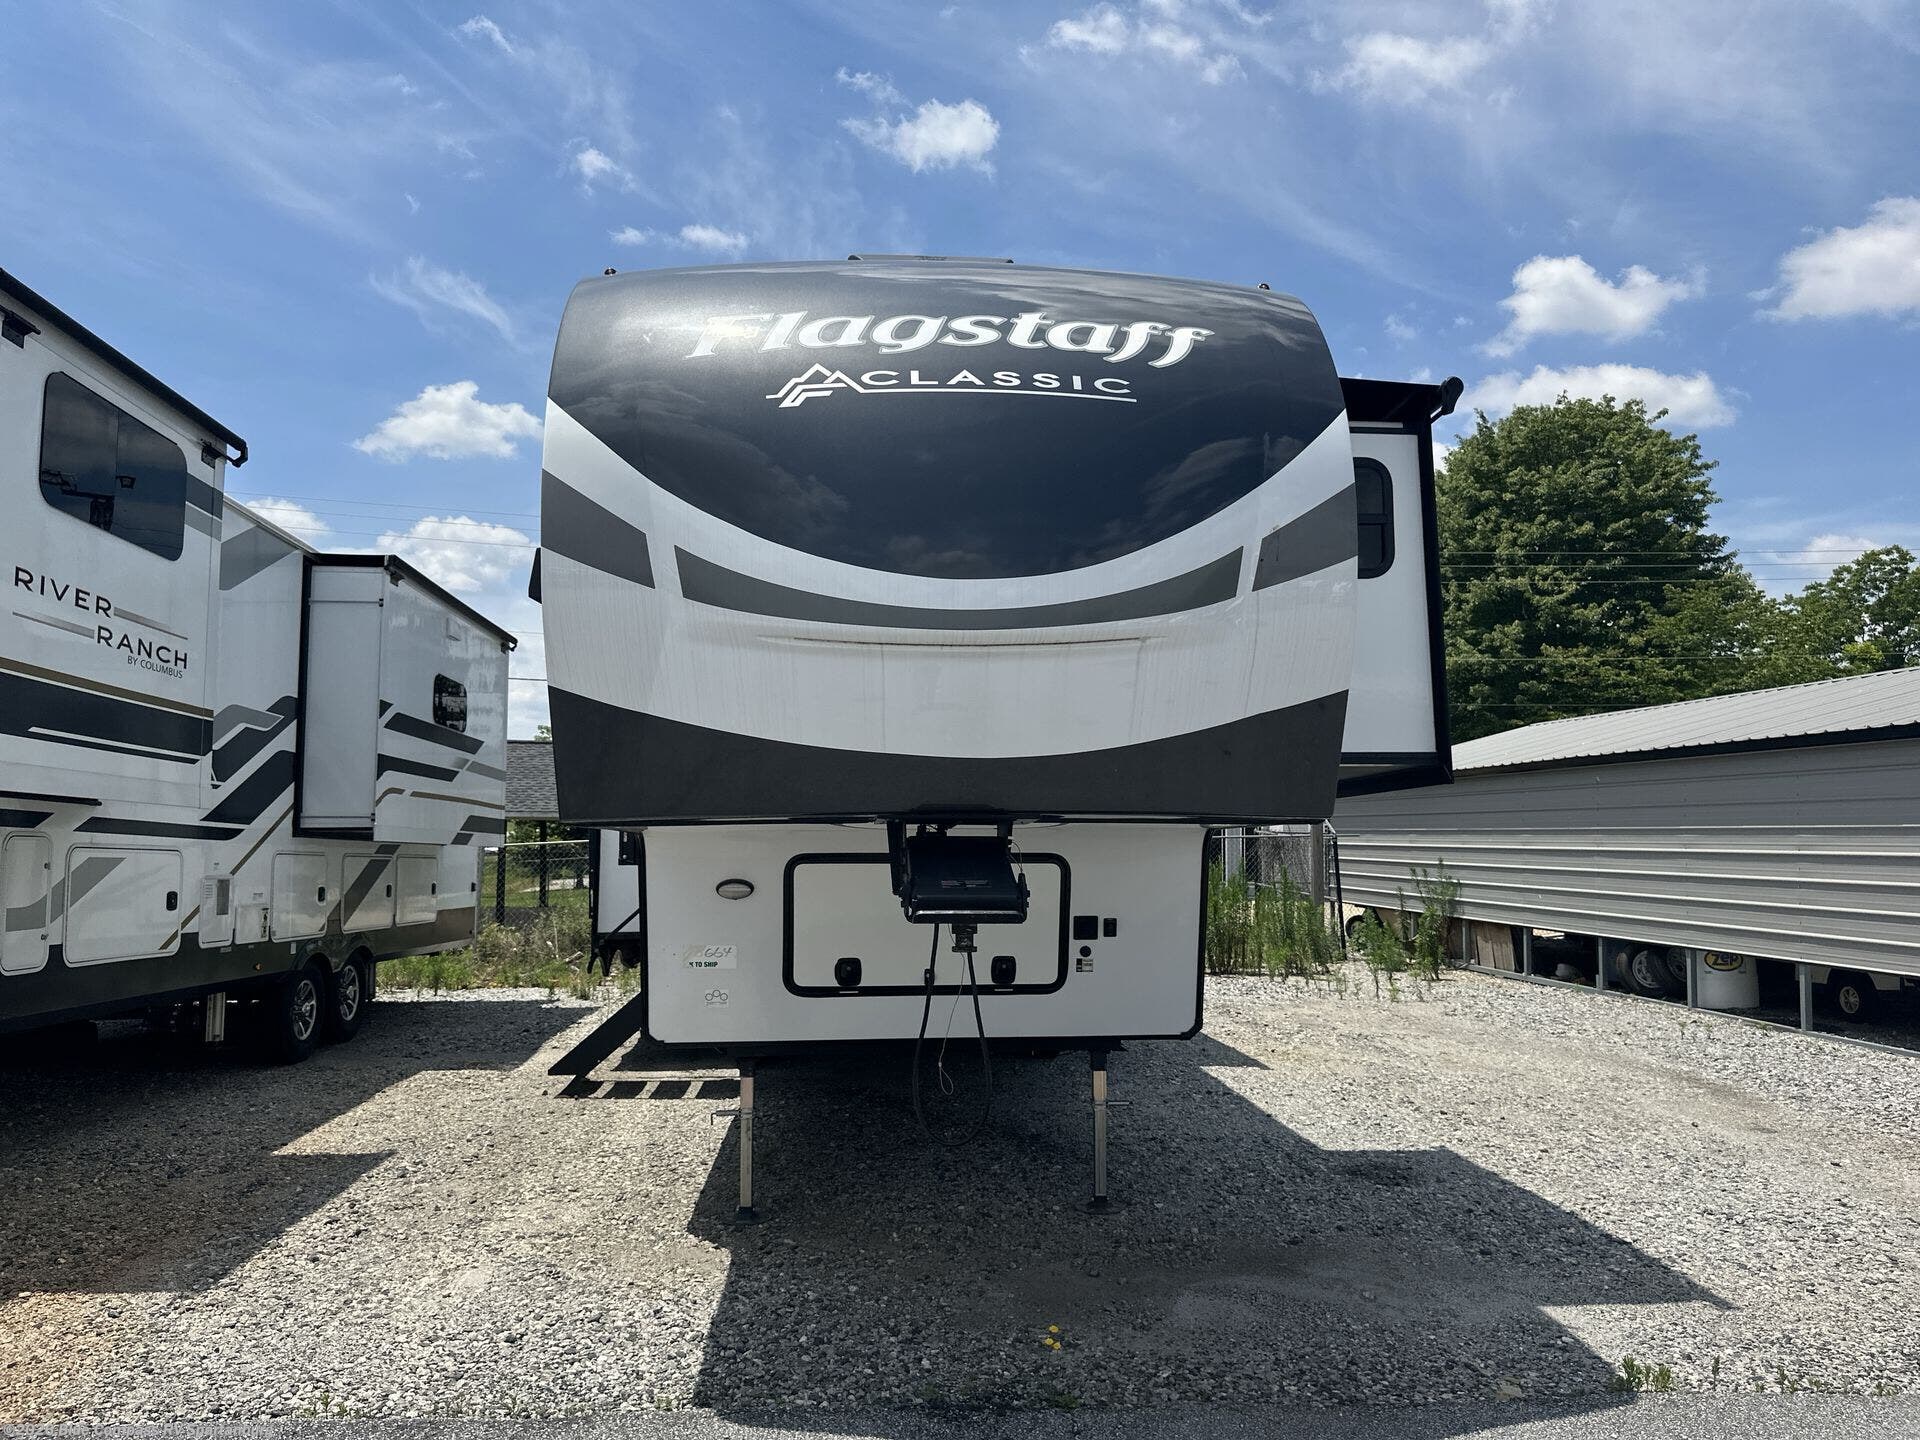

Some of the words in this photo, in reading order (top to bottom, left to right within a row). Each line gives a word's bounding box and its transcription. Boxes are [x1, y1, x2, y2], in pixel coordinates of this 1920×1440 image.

[684, 310, 1215, 368] Flagstaff
[860, 369, 1131, 393] CLASSIC
[14, 565, 112, 618] RIVER
[96, 625, 188, 669] RANCH
[127, 655, 138, 666] BY
[140, 659, 183, 679] COLUMBUS
